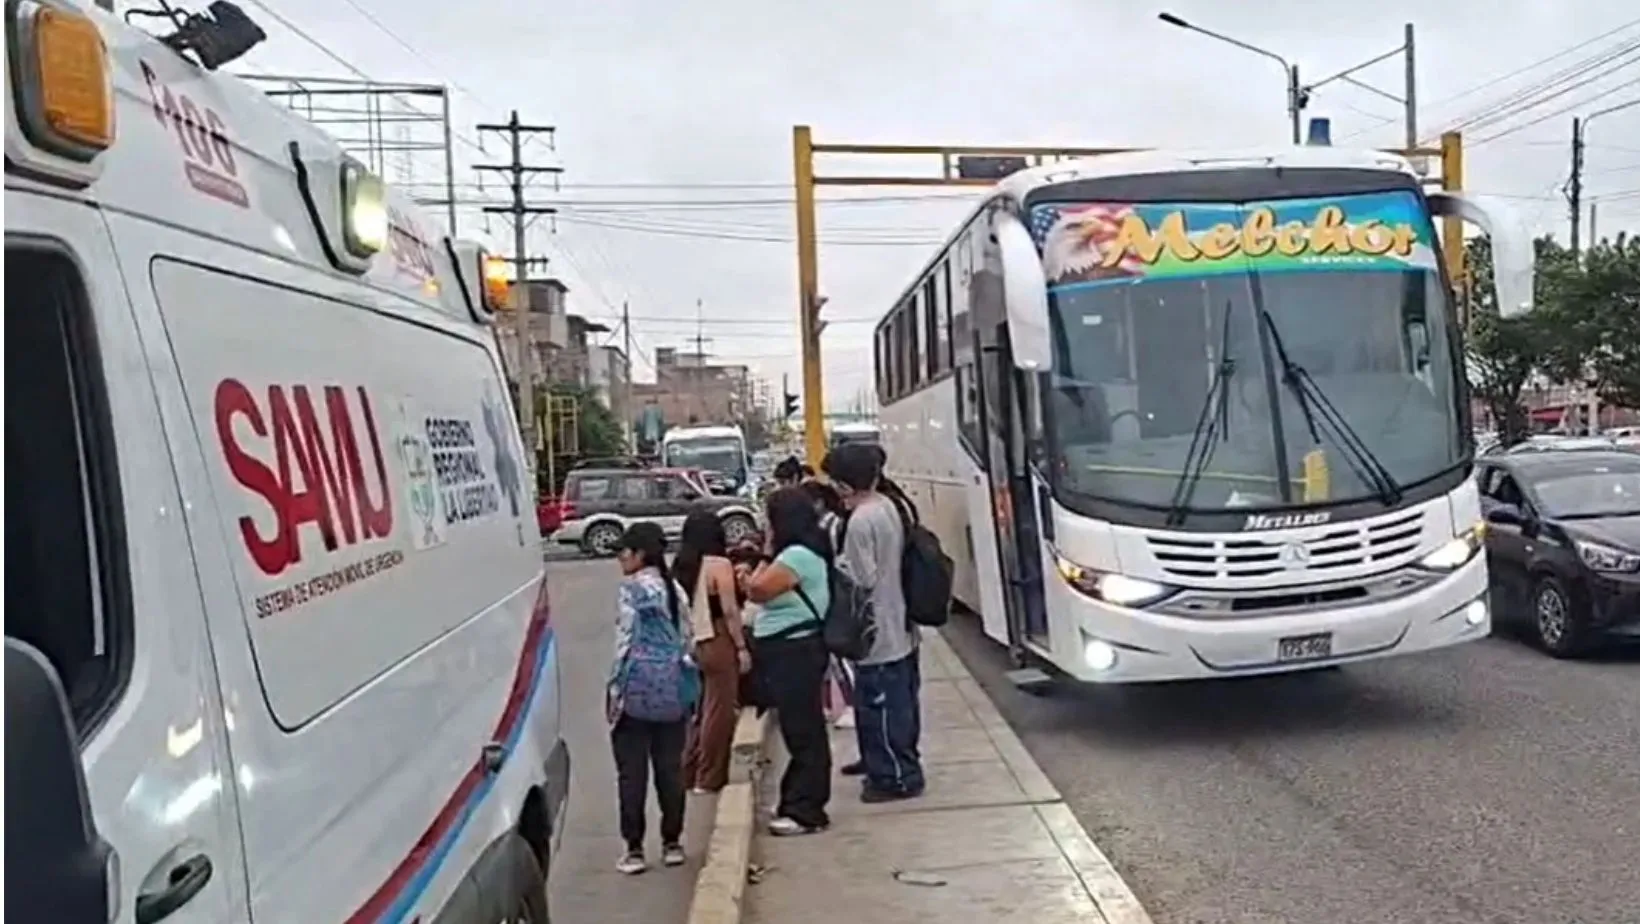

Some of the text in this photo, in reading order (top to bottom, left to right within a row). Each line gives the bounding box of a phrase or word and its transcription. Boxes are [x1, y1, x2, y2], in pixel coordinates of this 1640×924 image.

[1100, 205, 1416, 266] Melchor
[425, 416, 475, 448] GOBIERNO
[214, 377, 394, 576] SAMU
[432, 452, 486, 486] REGIONAL
[442, 488, 461, 525] LA
[456, 483, 500, 521] LIBERTAD
[255, 587, 294, 619] SISTEMA
